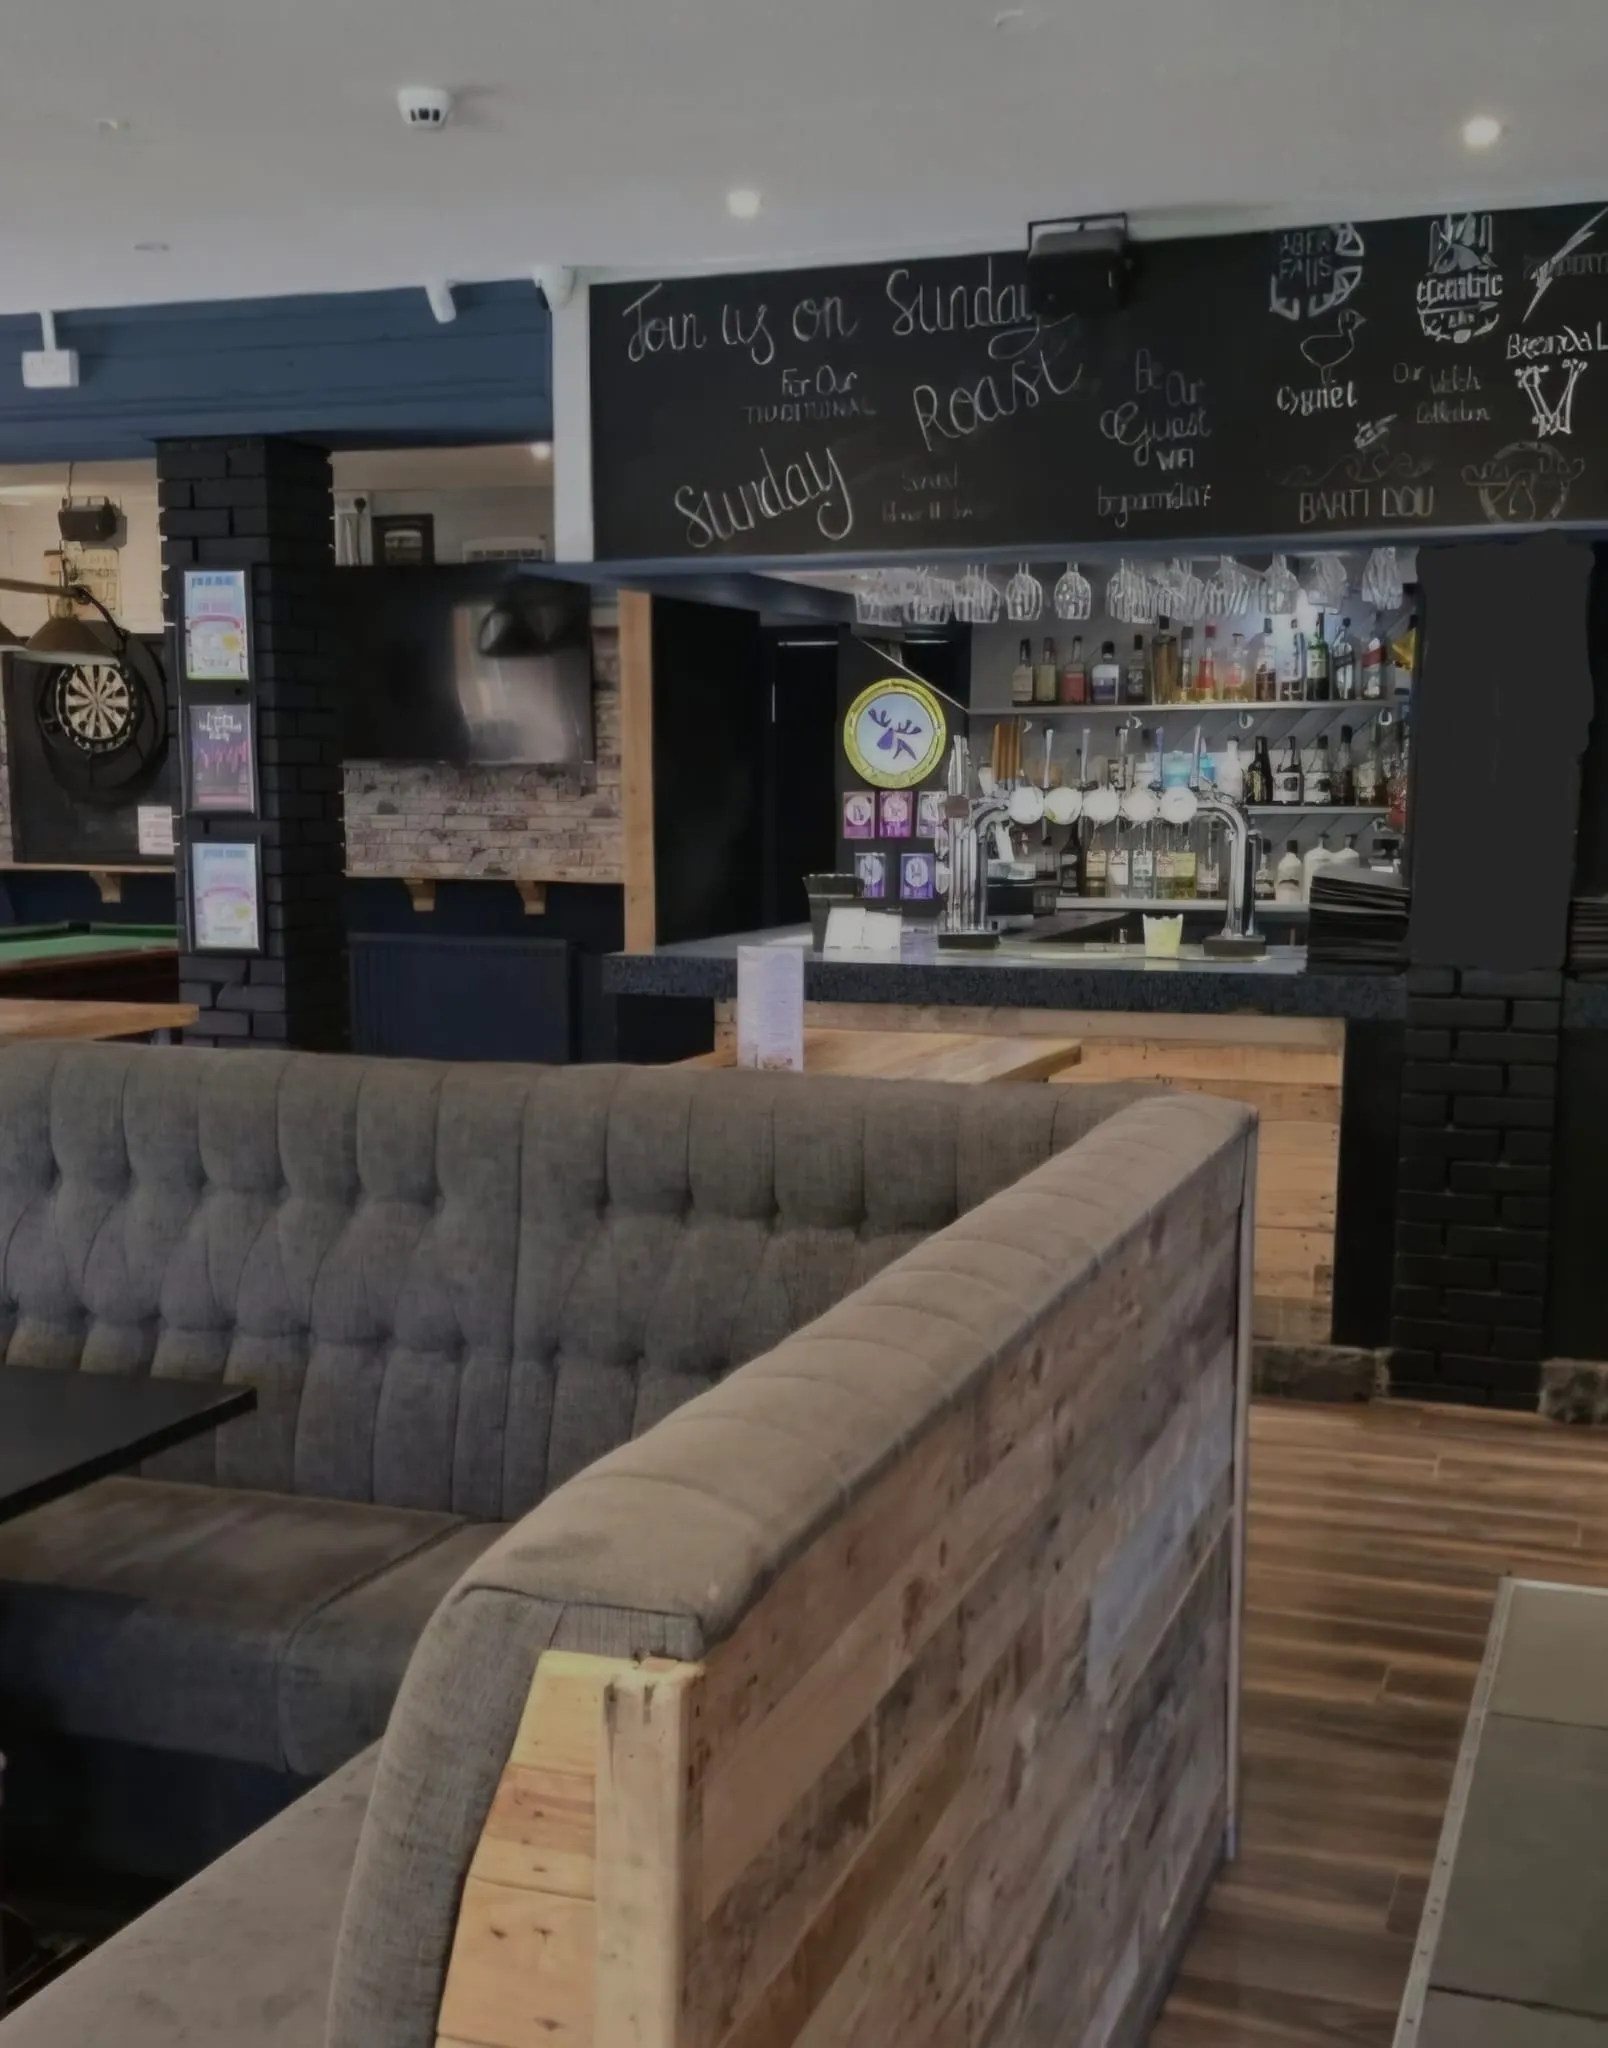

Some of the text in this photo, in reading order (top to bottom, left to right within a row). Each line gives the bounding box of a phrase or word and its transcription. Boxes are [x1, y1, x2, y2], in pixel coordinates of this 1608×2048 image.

[622, 256, 1070, 365] Join us on Sunday
[913, 350, 1083, 452] Roast
[674, 447, 853, 548] Sunday
